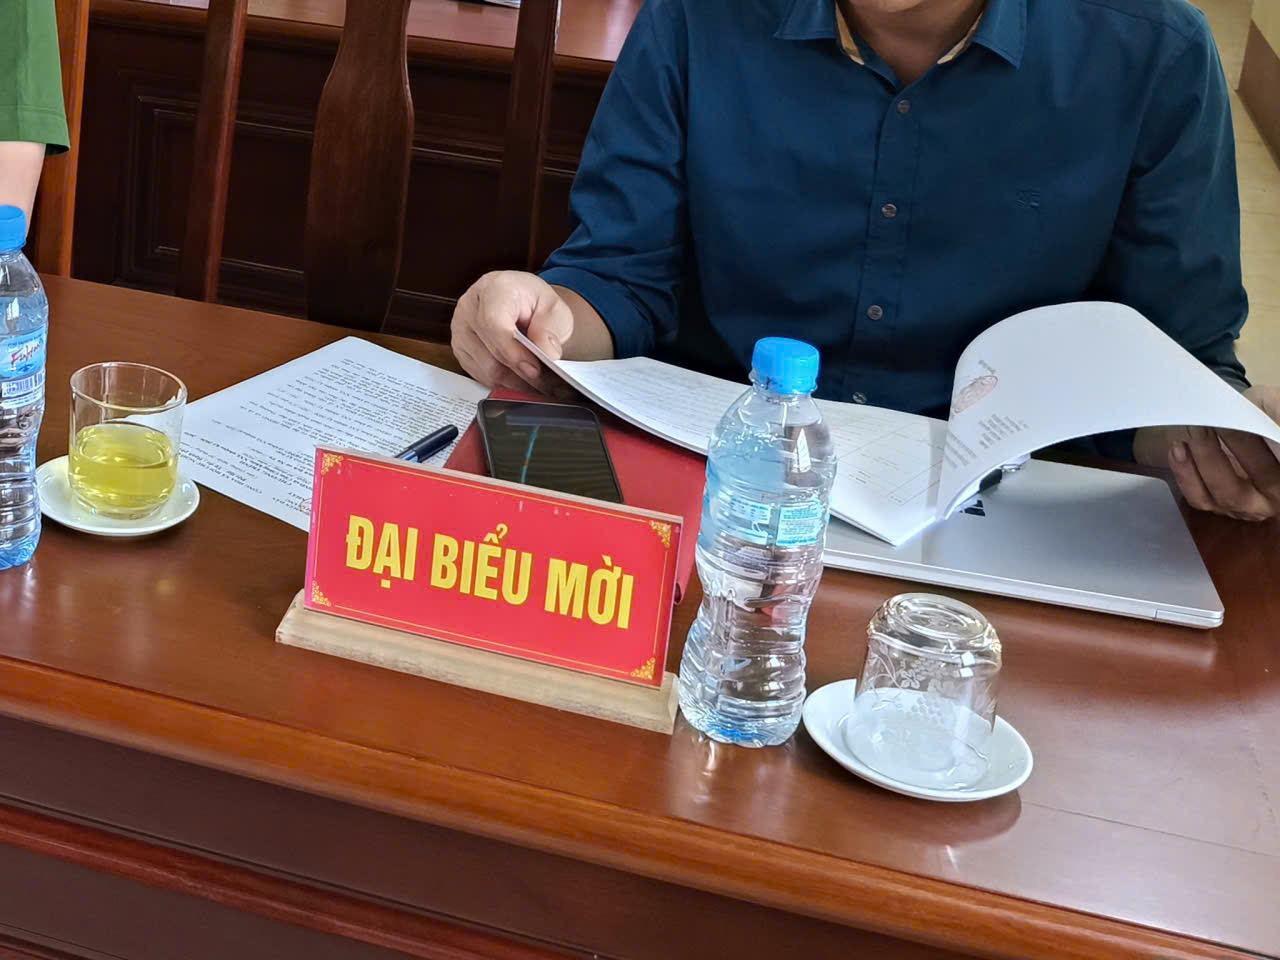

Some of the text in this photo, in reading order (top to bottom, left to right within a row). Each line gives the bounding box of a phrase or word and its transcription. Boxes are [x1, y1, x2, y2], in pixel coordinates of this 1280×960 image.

[345, 514, 634, 629] ĐẠI BIỂU MỜI
